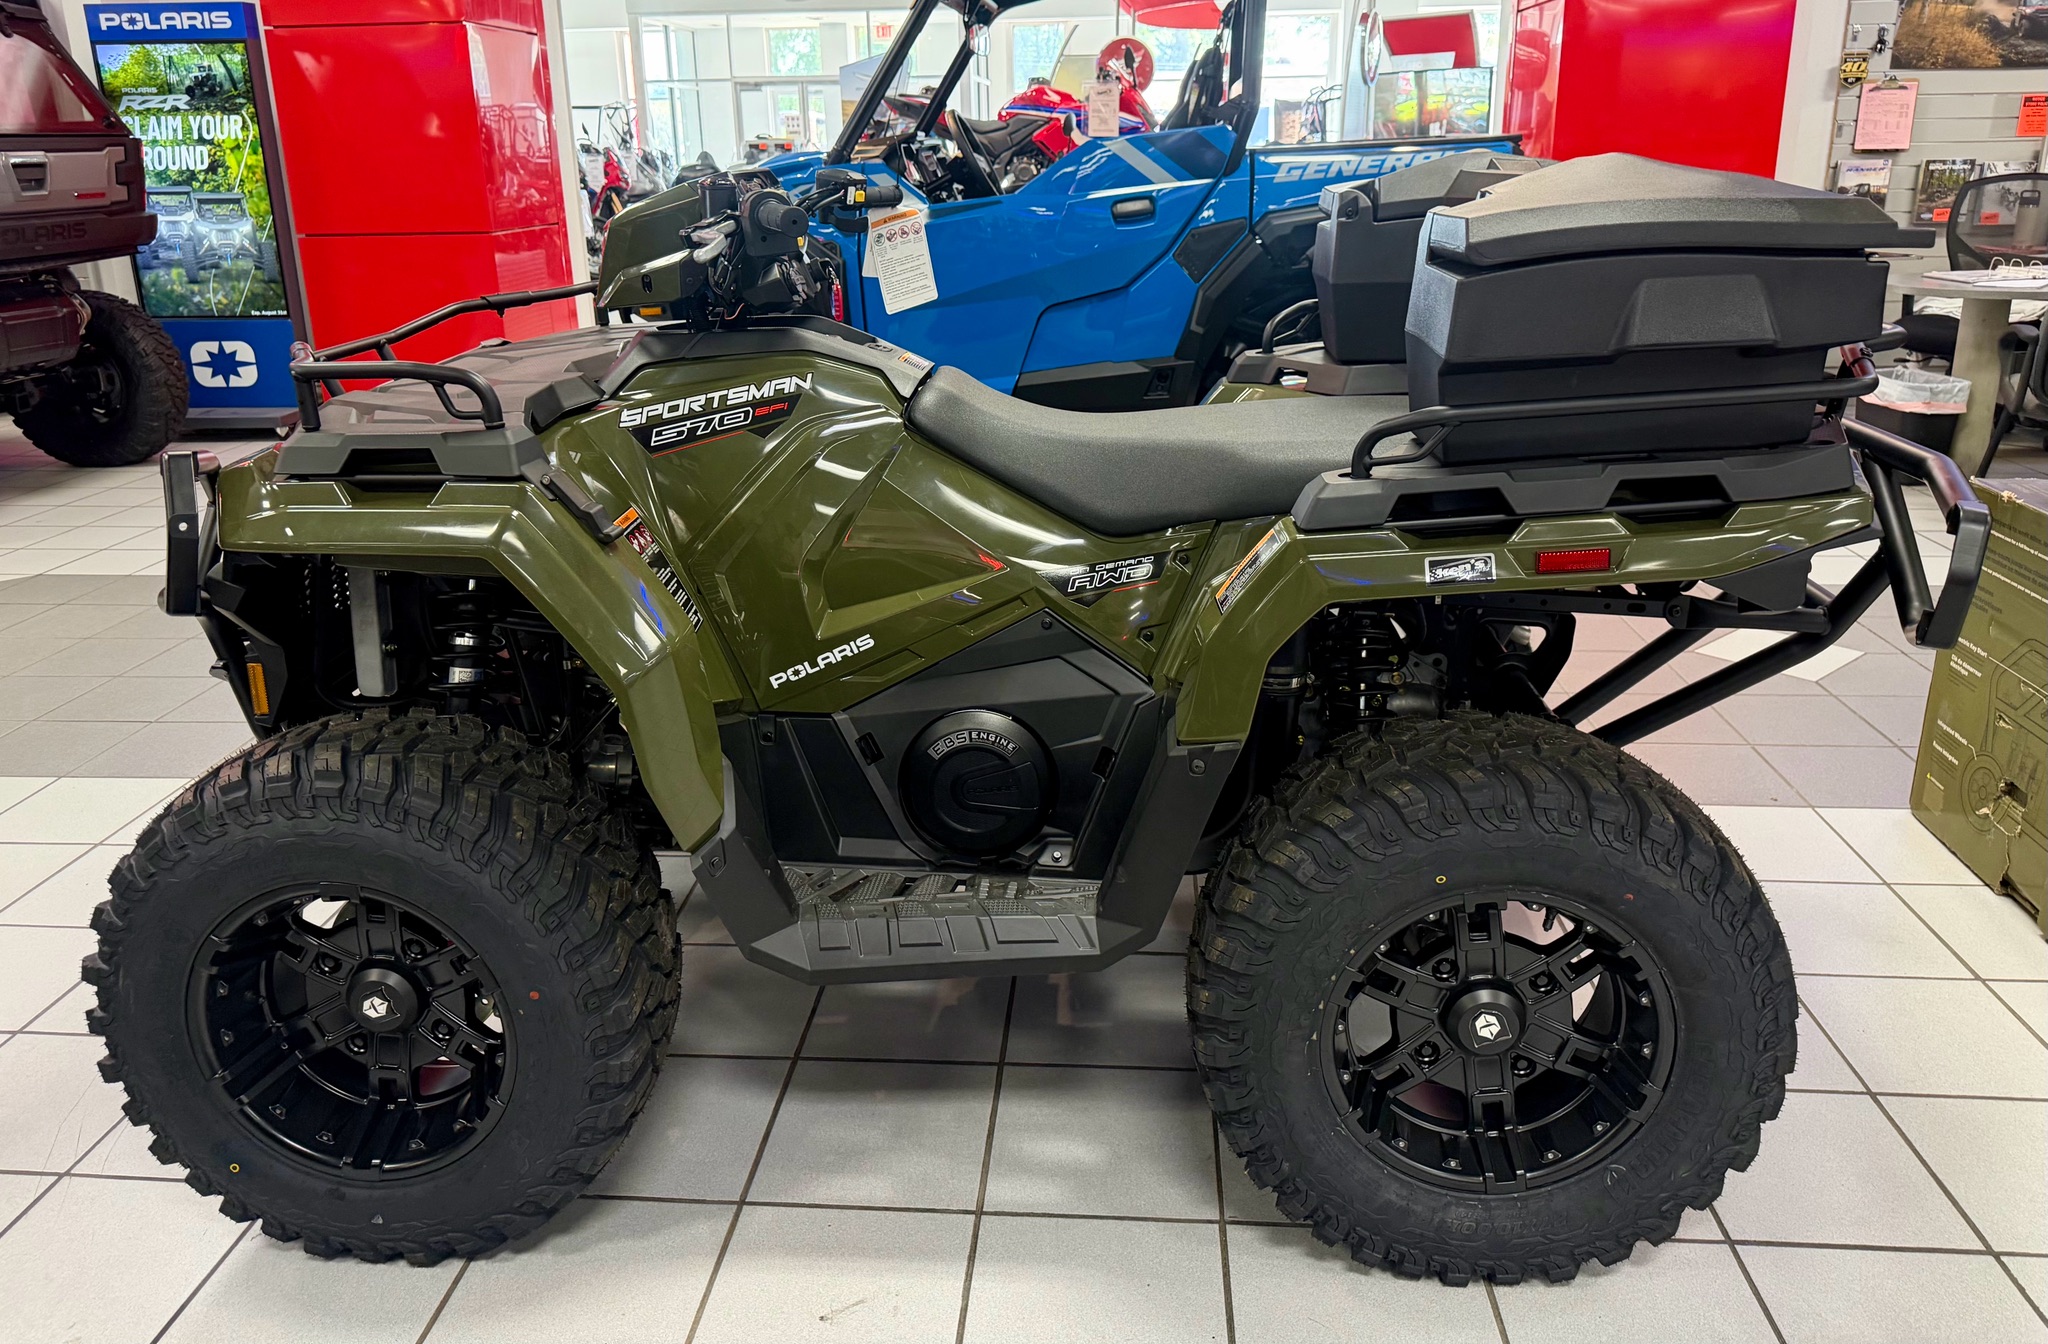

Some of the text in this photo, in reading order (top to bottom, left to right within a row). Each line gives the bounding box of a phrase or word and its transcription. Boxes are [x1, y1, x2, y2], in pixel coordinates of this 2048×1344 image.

[98, 11, 233, 31] POLARIS
[876, 24, 892, 38] EXIT
[1841, 62, 1868, 72] 40
[118, 94, 192, 112] RZR
[188, 115, 243, 140] YOUR
[144, 145, 209, 170] ROUND
[0, 222, 87, 245] OLARIS
[619, 371, 813, 428] SPORTSMAN
[651, 402, 788, 447] 570 EFI
[1067, 563, 1153, 592] AWD
[1070, 556, 1154, 575] ON DEMAND
[769, 633, 875, 690] POLARIS
[1977, 647, 1987, 658] Start
[932, 731, 1016, 756] EBS ENGINE
